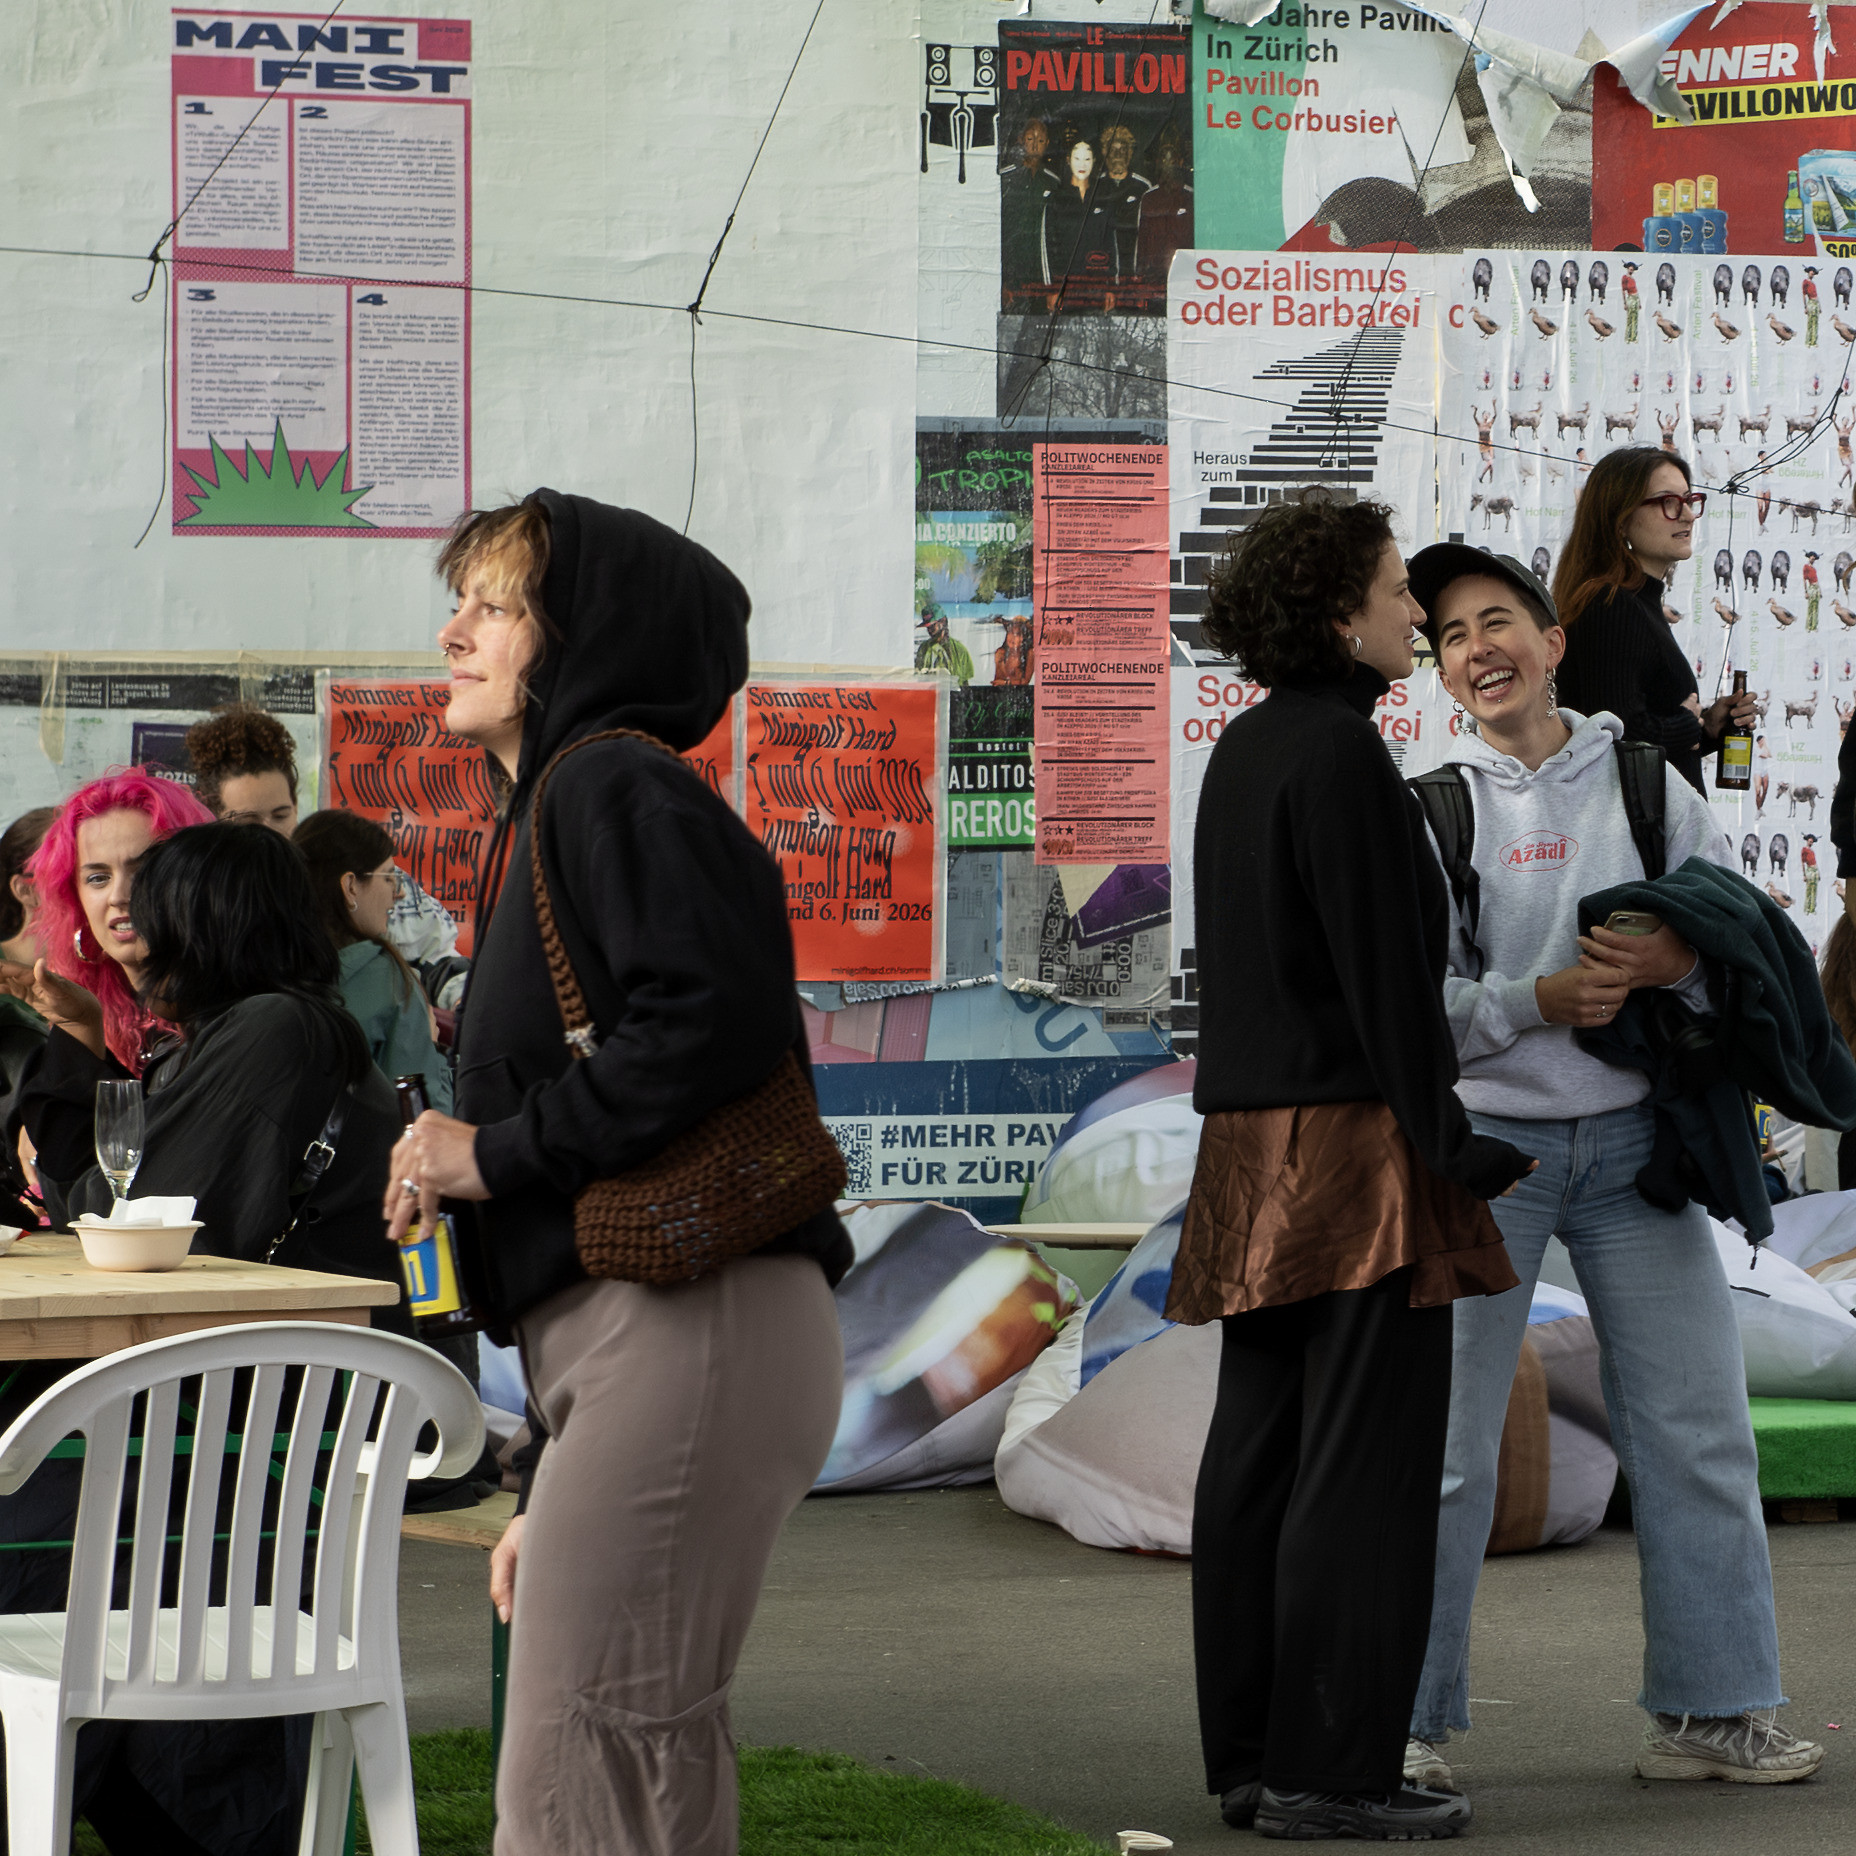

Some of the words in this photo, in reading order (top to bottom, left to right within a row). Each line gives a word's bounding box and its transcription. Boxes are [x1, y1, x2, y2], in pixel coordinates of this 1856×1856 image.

[1270, 3, 1350, 29] Jahre
[175, 20, 405, 54] MANI
[1087, 26, 1104, 45] LE
[1206, 35, 1231, 59] In
[1245, 32, 1339, 62] Zürich
[261, 61, 468, 93] FEST
[1007, 50, 1186, 94] PAVILLON
[1657, 43, 1800, 85] ENNER
[1206, 69, 1320, 97] Pavillon
[185, 102, 213, 115] 1
[299, 106, 329, 119] 2
[1206, 105, 1243, 130] Le
[1254, 106, 1398, 135] Corbusier
[1195, 258, 1407, 294] Sozialismus
[187, 289, 216, 302] 3
[356, 293, 388, 306] 4
[1181, 294, 1263, 327] oder
[1272, 295, 1421, 328] Barbarei
[966, 449, 1034, 462] ASALTO
[1041, 452, 1163, 465] POLITWOCHENENDE
[1193, 450, 1247, 466] Heraus
[1201, 471, 1233, 484] zum
[935, 522, 1016, 543] CONZIERTO
[1042, 662, 1165, 674] POLITWOCHENENDE
[331, 684, 415, 707] Sommer
[419, 685, 452, 707] Fes
[749, 687, 830, 710] Sommer
[837, 688, 878, 711] Fest
[340, 710, 431, 761] Minigolf
[759, 712, 845, 761] Minigolf
[847, 718, 897, 752] Hard
[951, 799, 1036, 838] REROS
[788, 902, 814, 921] nd
[819, 903, 837, 921] 6.
[841, 902, 881, 926] Juni
[887, 902, 933, 922] 2026
[881, 1122, 996, 1148] #MEHR
[1006, 1121, 1066, 1146] PAV
[881, 1154, 947, 1185] FÜR
[957, 1153, 1041, 1184] ZÜRI
